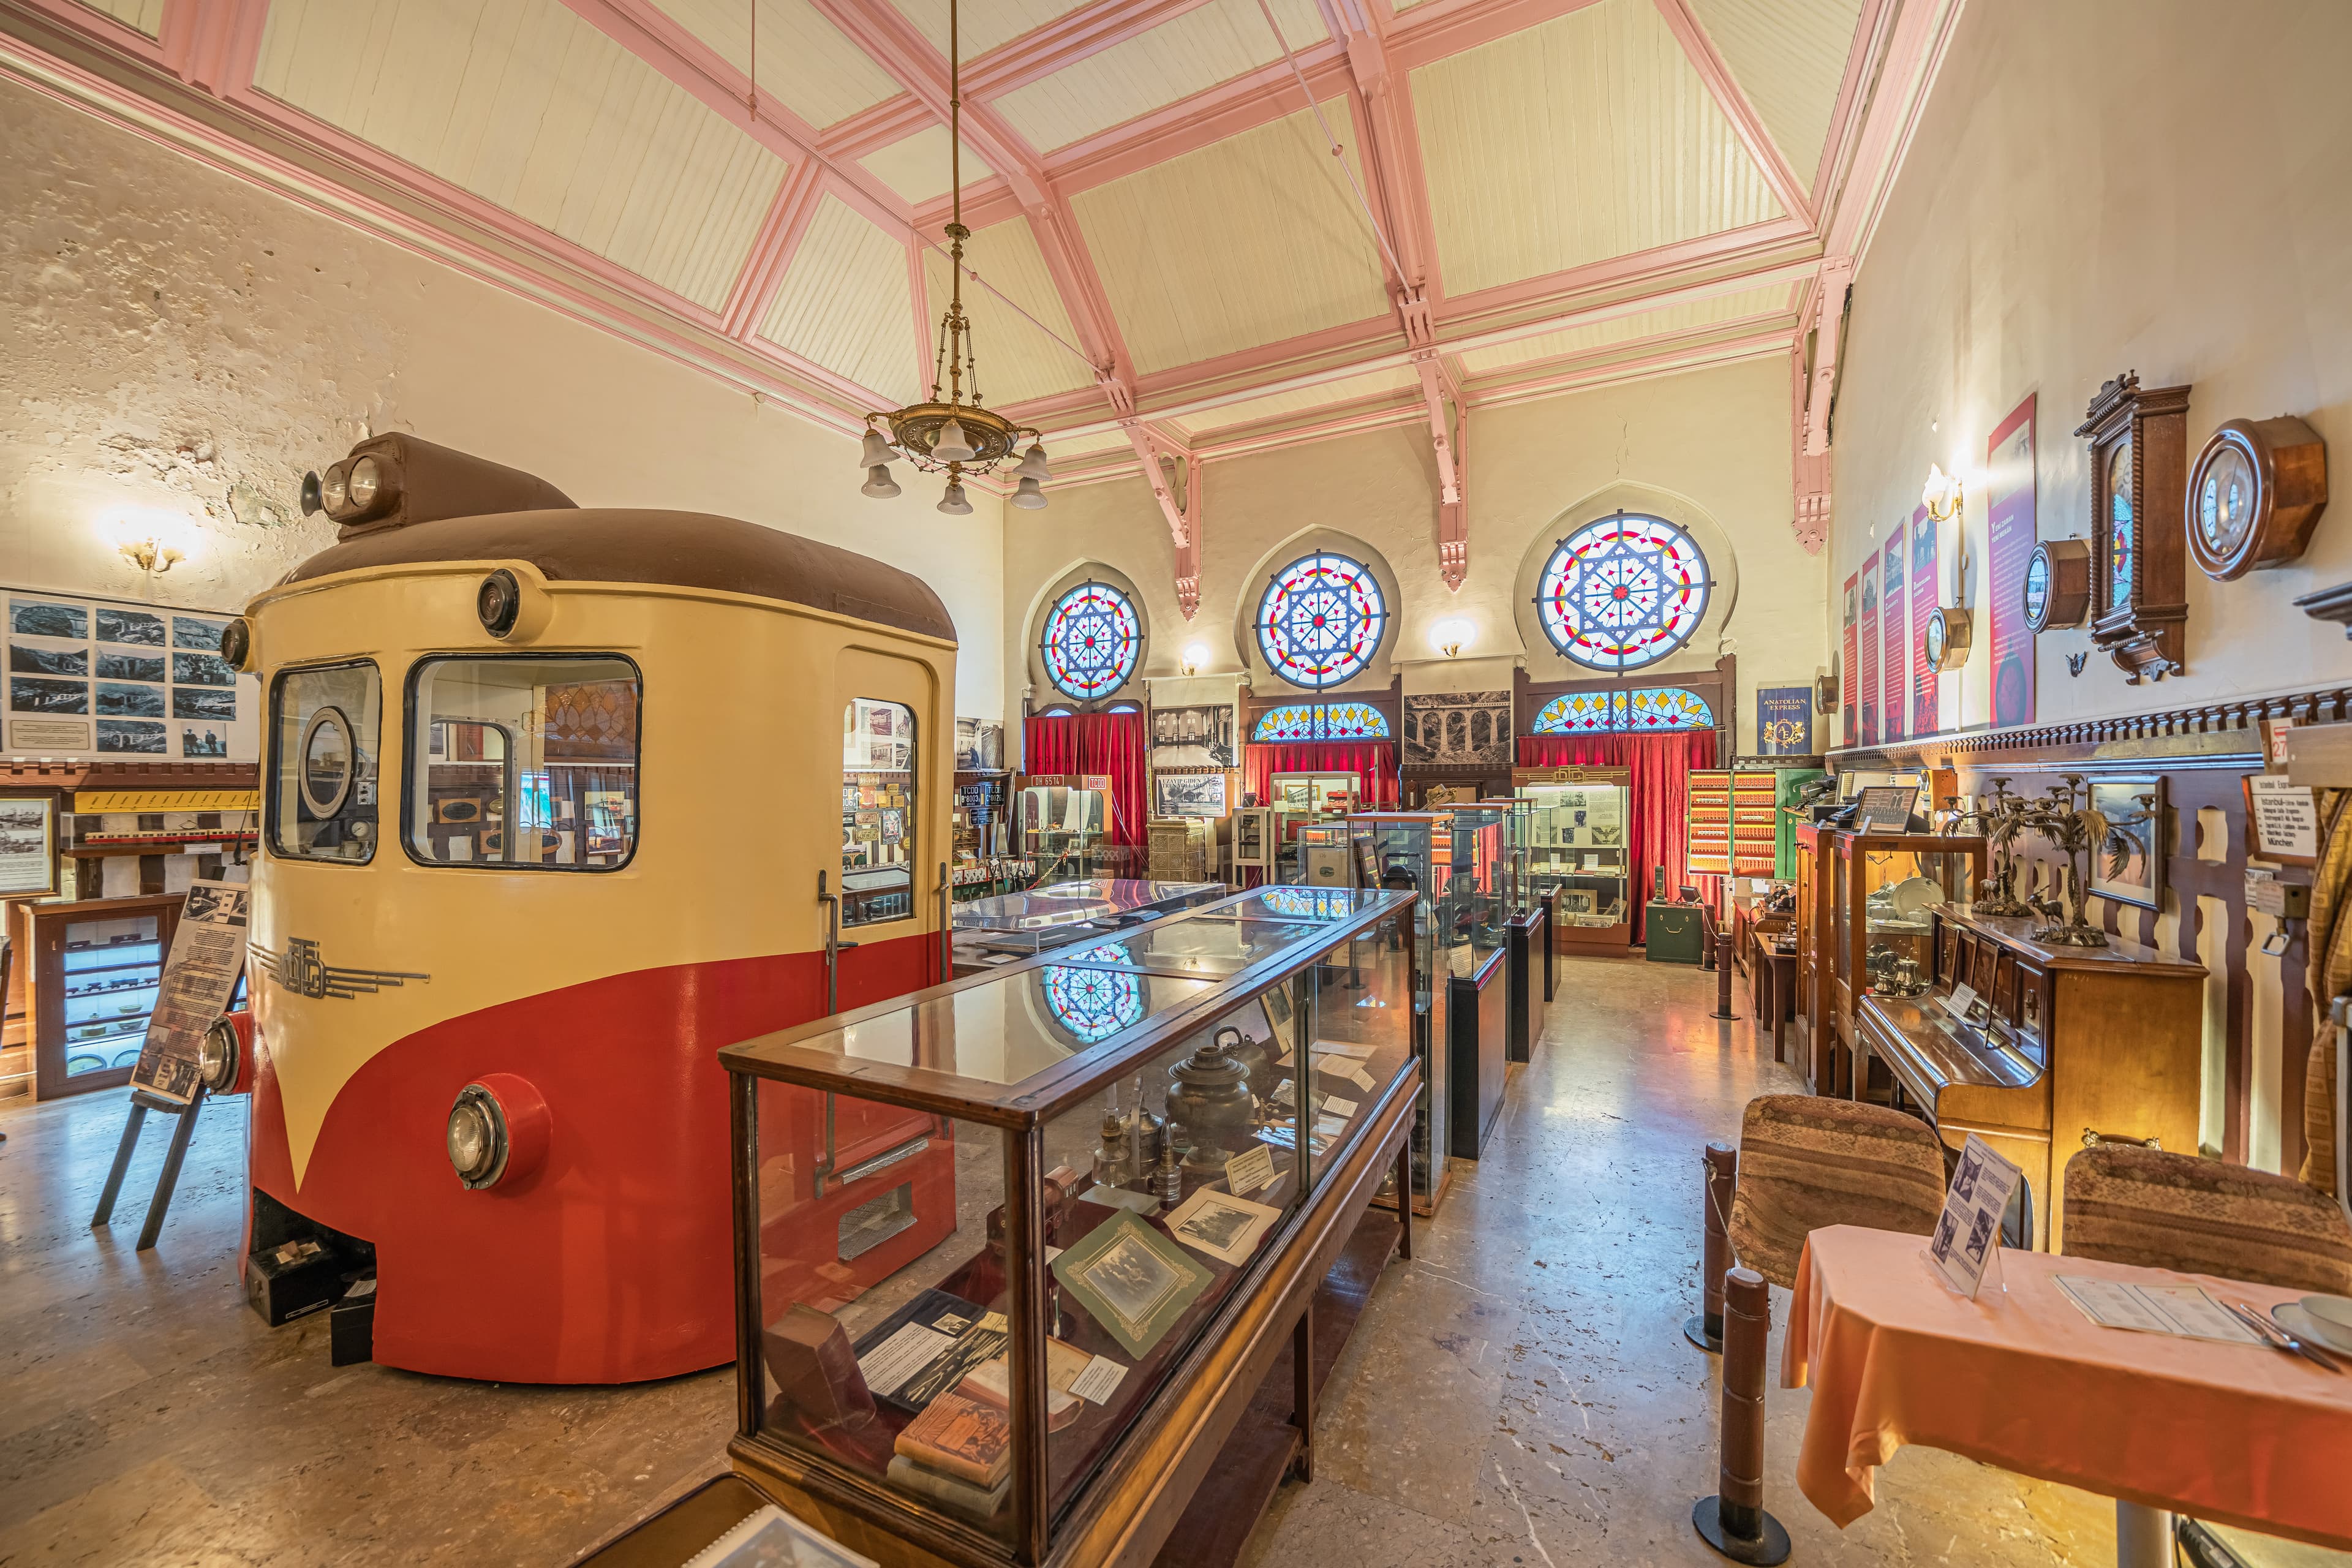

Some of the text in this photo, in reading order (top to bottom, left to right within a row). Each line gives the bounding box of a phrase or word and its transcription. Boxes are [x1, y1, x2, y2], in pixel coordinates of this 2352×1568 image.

[1035, 776, 1060, 785] DH 6514
[1090, 778, 1104, 788] TCDD
[2267, 837, 2294, 847] München
